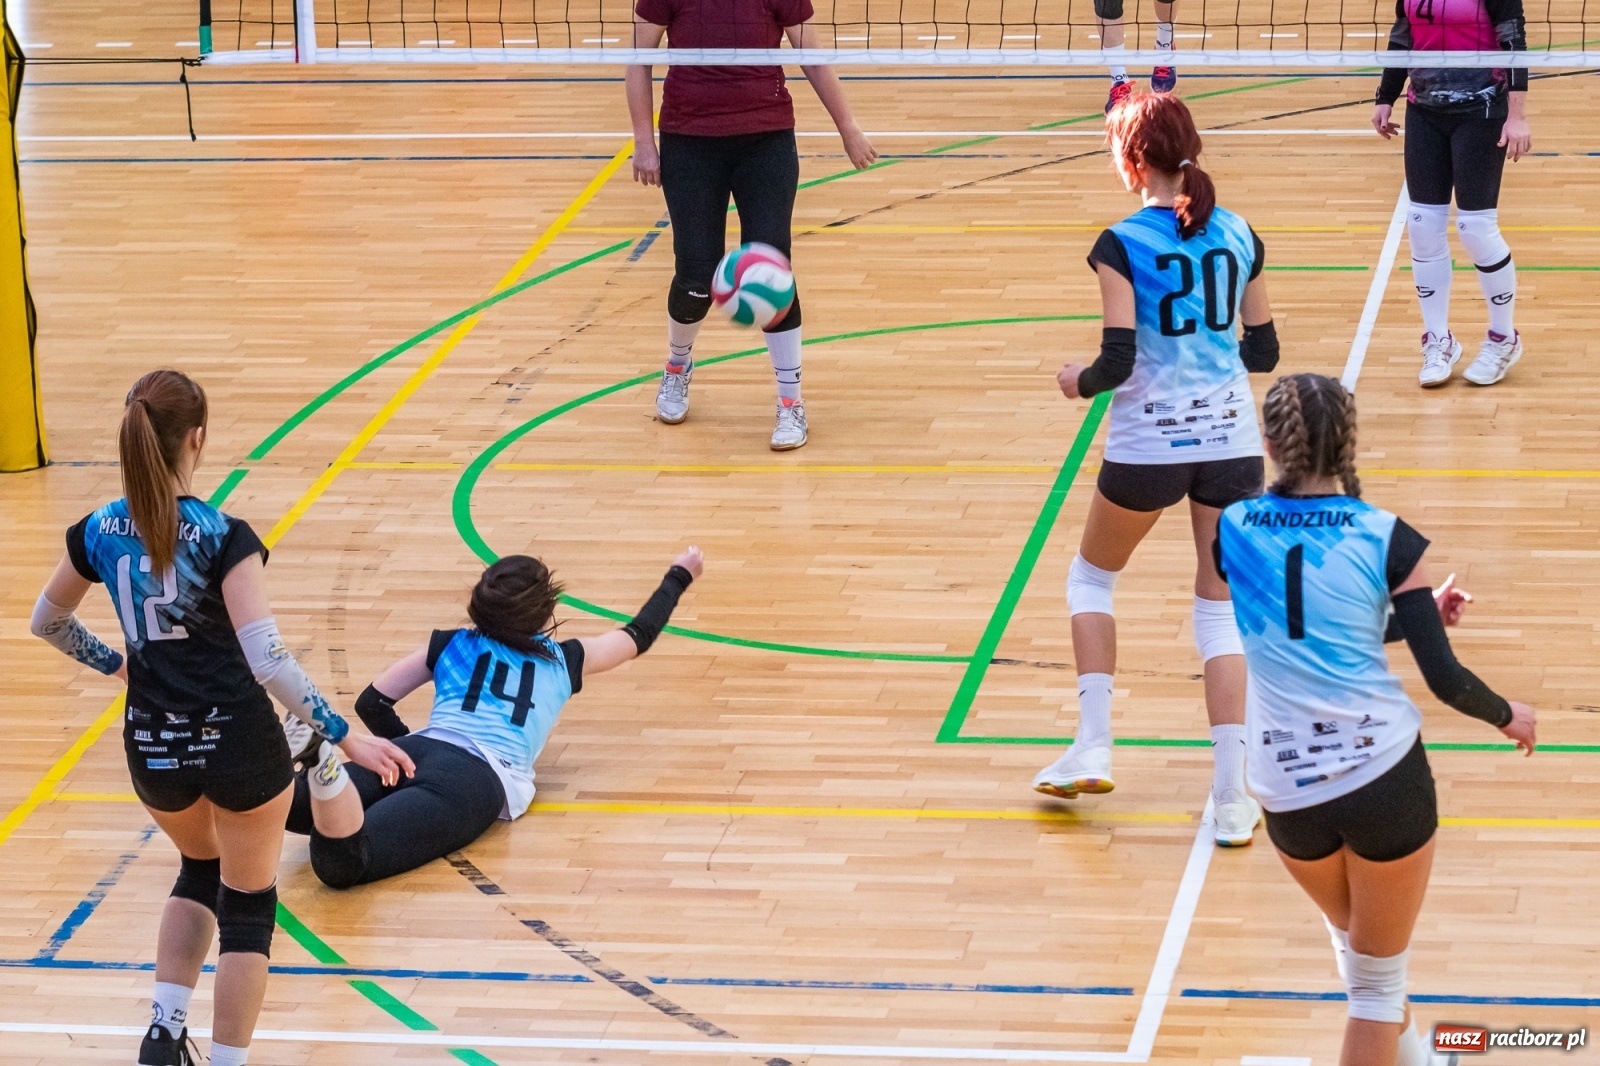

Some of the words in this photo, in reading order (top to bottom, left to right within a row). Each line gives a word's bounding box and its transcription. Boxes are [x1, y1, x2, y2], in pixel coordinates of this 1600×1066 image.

[1155, 248, 1239, 337] 20
[1242, 510, 1356, 528] MANDZIUK
[116, 553, 190, 642] 12
[1285, 543, 1305, 640] 1
[461, 651, 536, 728] 14
